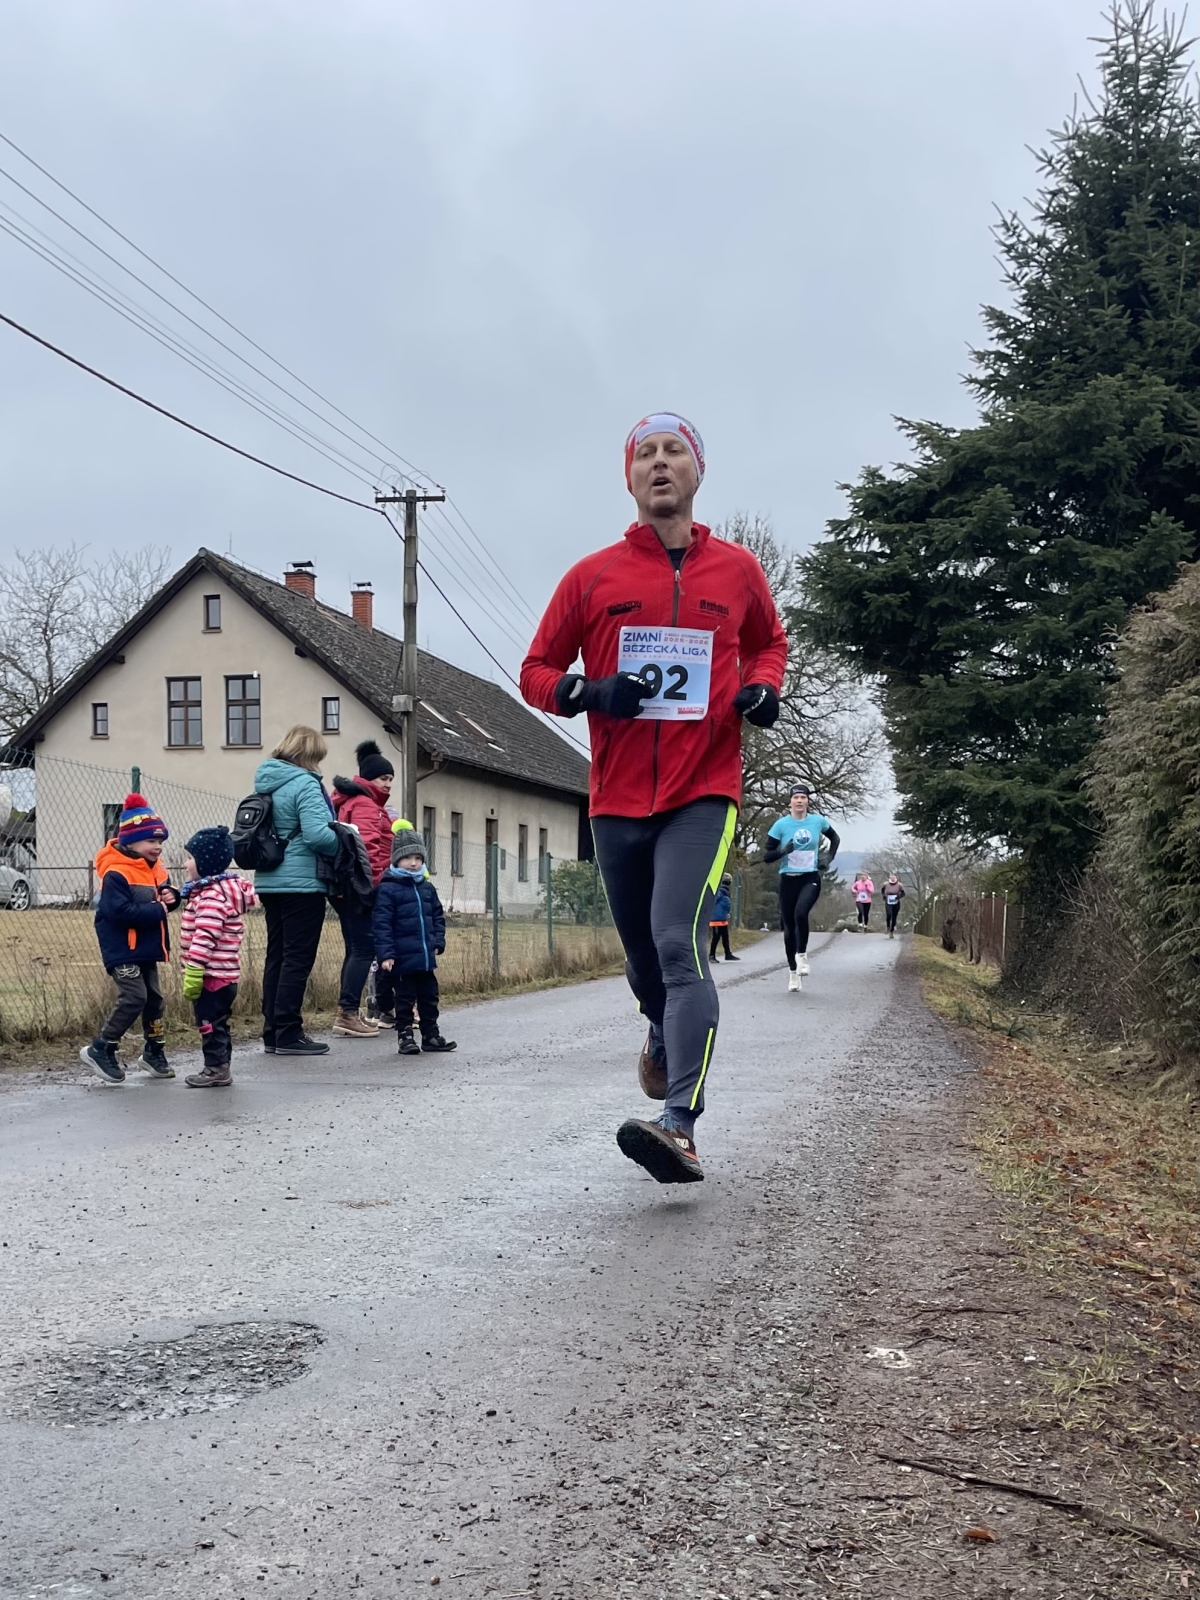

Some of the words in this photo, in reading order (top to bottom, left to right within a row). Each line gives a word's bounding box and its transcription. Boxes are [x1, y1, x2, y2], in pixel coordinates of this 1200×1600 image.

[623, 631, 662, 642] ZIMNÍ
[623, 643, 679, 654] BĚŽECKÁ
[682, 647, 708, 656] LIGA
[639, 663, 688, 701] 92
